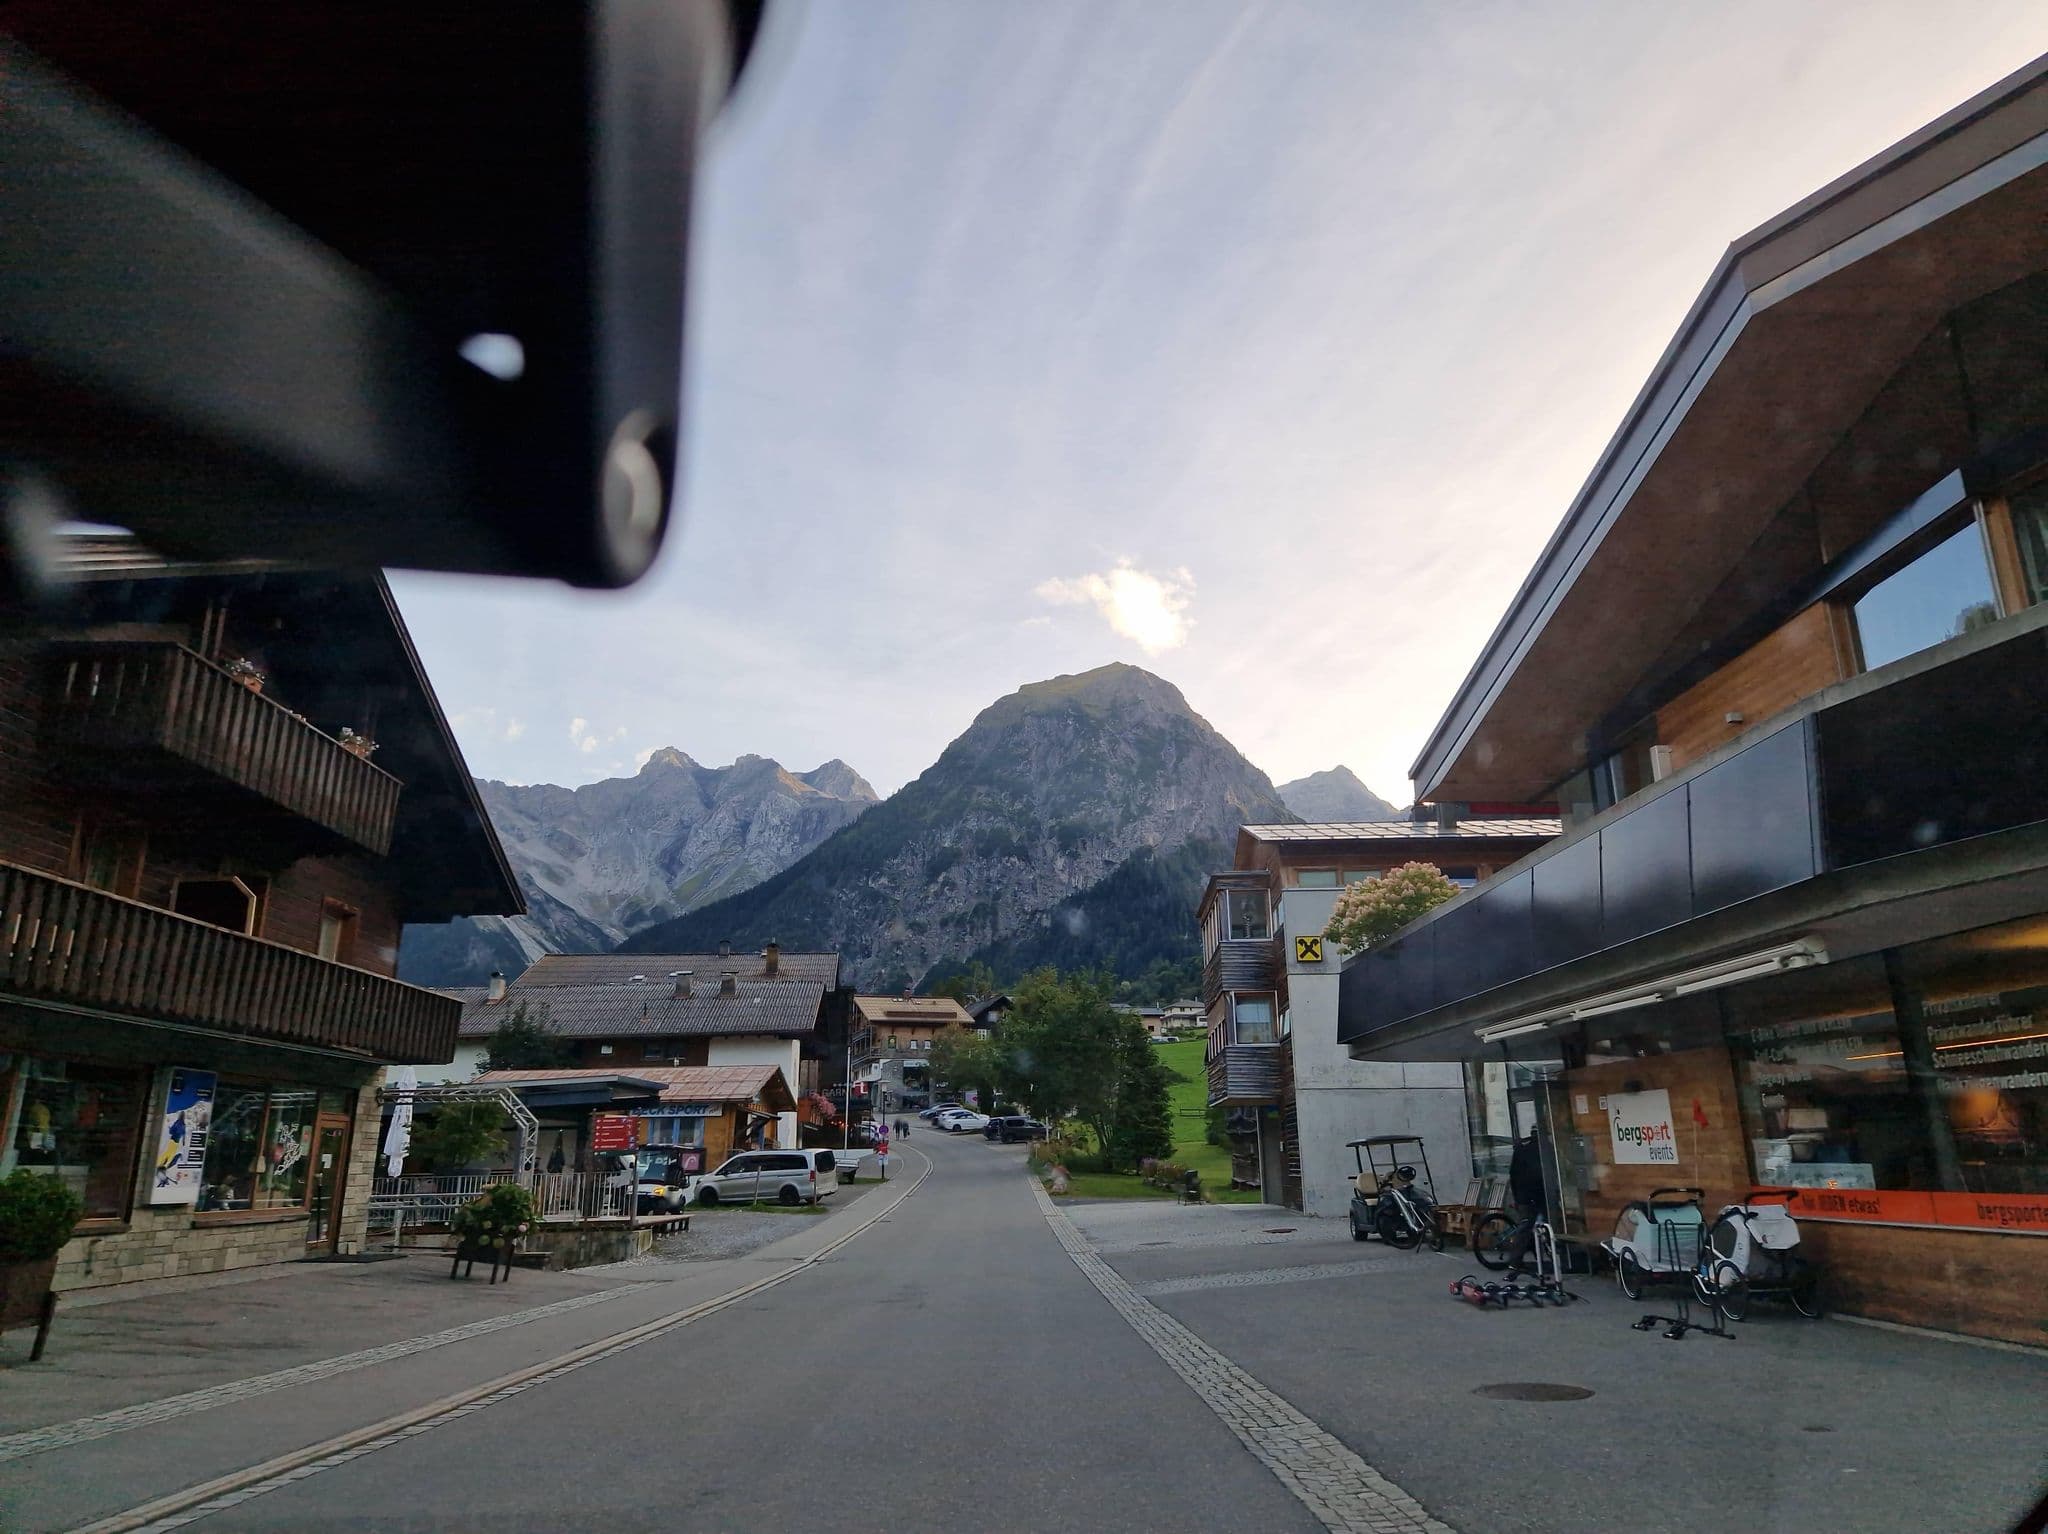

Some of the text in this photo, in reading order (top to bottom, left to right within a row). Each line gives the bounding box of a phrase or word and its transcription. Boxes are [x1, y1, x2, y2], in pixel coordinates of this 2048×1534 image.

[667, 1103, 710, 1115] SPORT
[1617, 1121, 1671, 1146] bergsport
[1649, 1145, 1674, 1161] events
